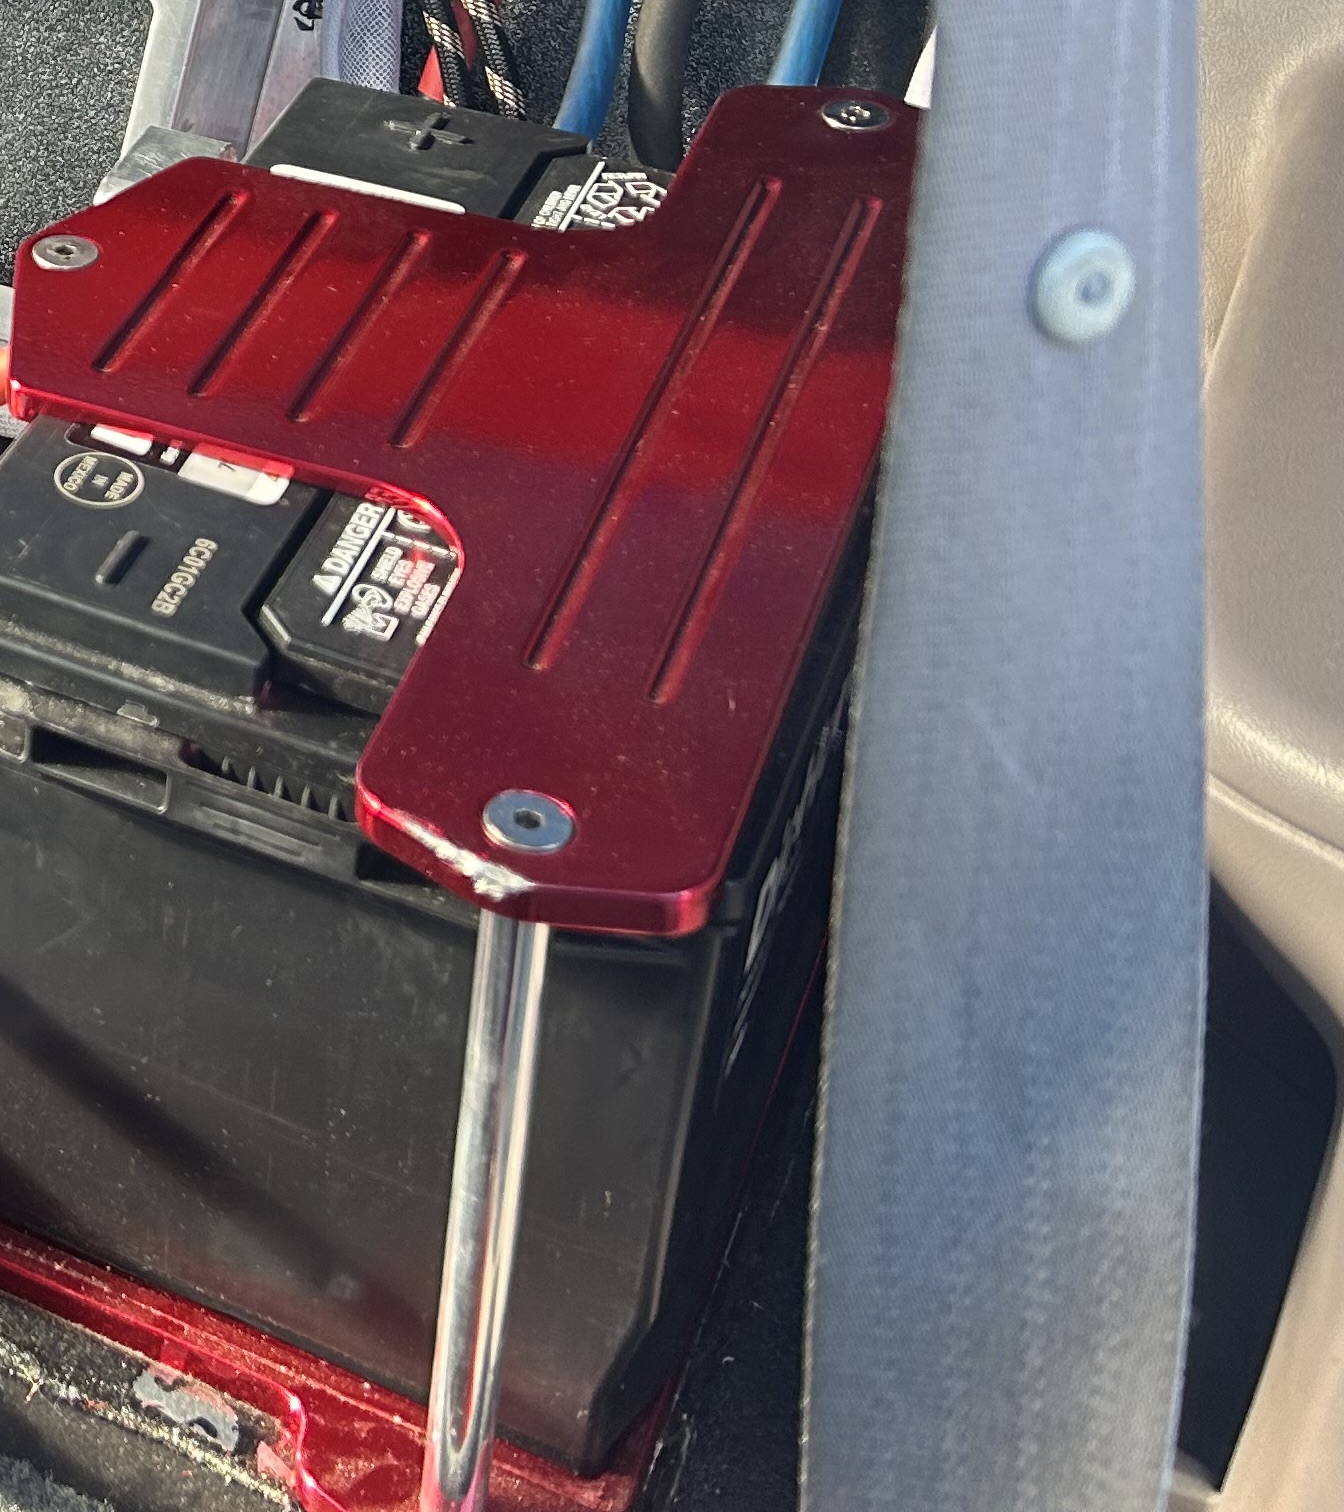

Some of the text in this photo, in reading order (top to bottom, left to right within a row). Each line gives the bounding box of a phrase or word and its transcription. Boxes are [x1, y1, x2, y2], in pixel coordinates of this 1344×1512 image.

[63, 455, 99, 494] MEXICO
[91, 473, 109, 487] IN
[104, 471, 134, 501] MADE
[321, 502, 386, 577] DANGER
[151, 537, 218, 618] 6C01GC2B
